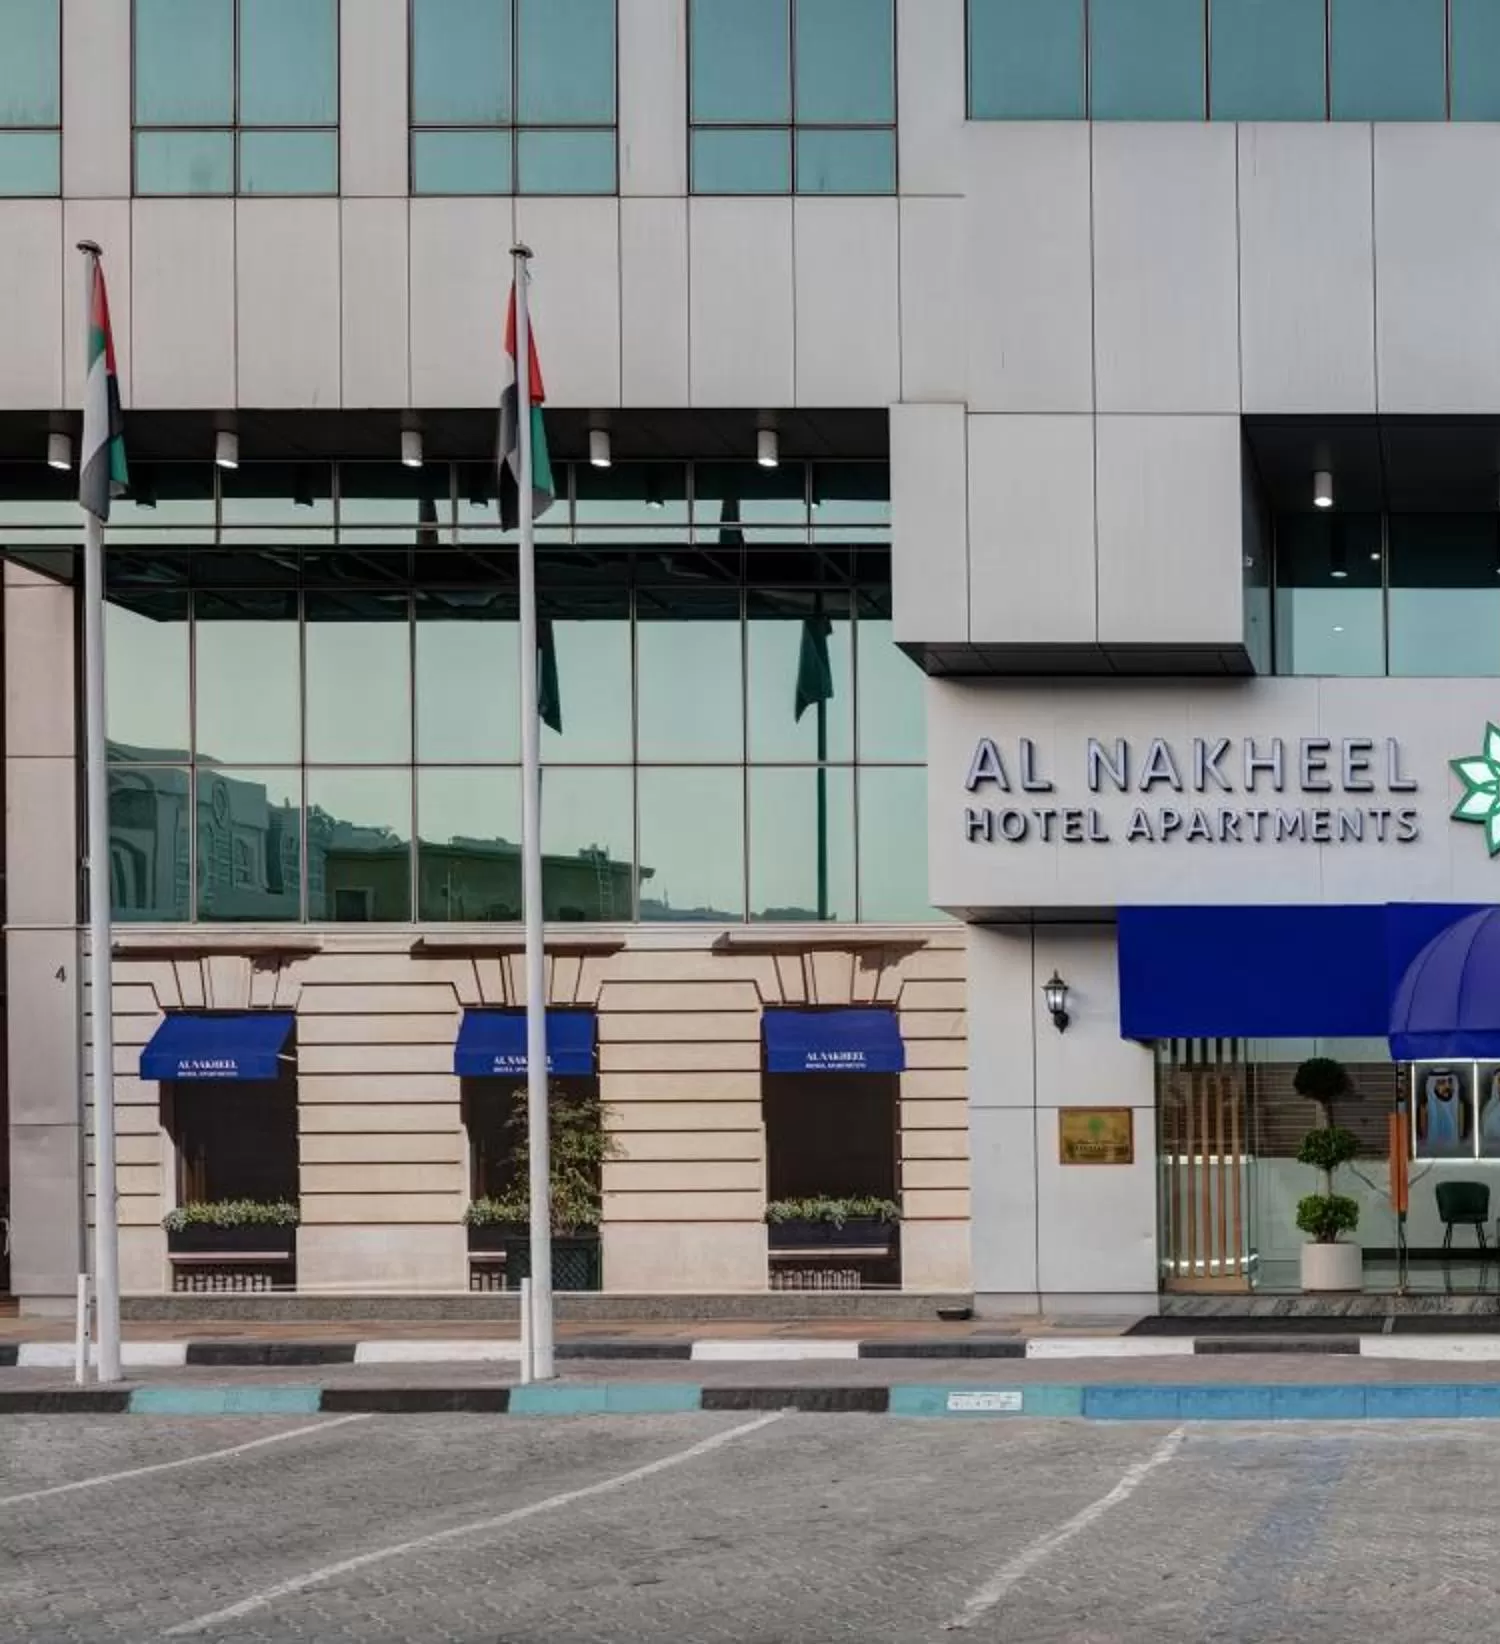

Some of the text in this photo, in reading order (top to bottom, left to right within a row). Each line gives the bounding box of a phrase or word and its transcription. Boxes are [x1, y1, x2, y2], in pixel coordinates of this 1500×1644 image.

[965, 737, 1419, 793] AL NAKHEEL
[965, 807, 1420, 844] HOTEL APARTMENTS
[54, 965, 67, 983] 4
[507, 1056, 554, 1065] NAKL
